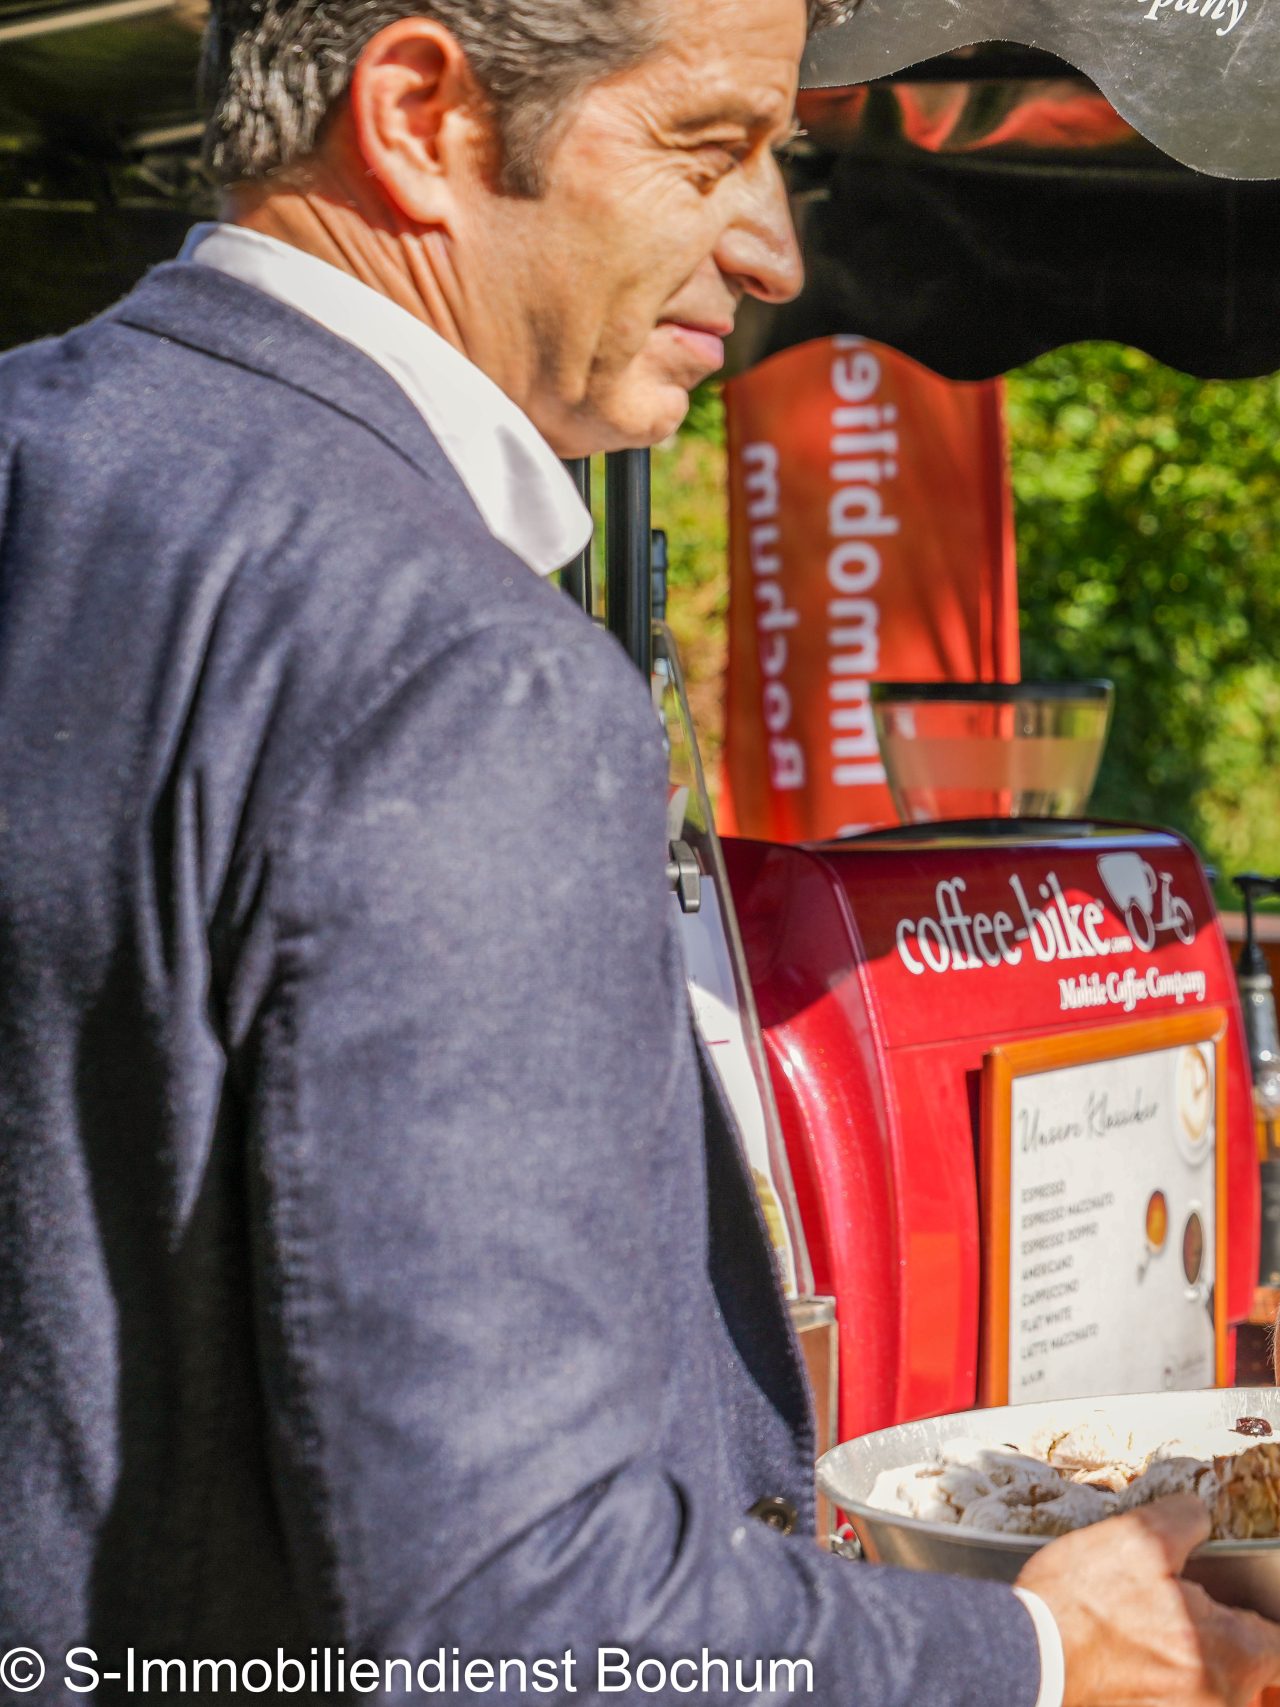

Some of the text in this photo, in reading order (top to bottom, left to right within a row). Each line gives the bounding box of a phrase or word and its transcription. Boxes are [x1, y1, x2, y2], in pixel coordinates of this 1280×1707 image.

[1138, 0, 1248, 36] pany
[1058, 966, 1206, 1012] Mobile Coffee Company
